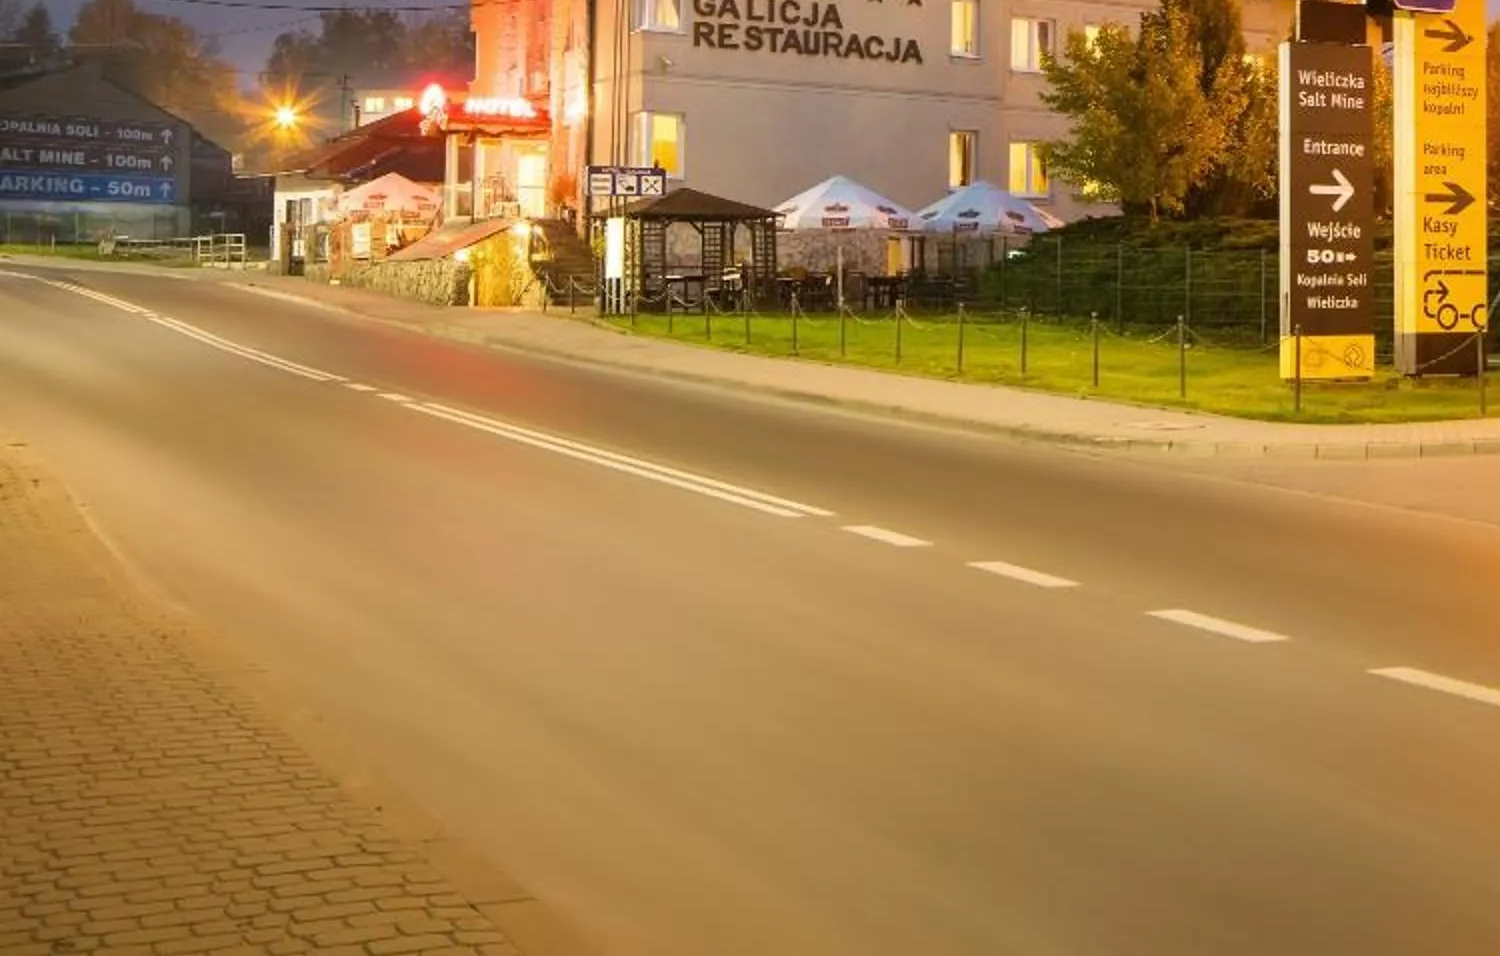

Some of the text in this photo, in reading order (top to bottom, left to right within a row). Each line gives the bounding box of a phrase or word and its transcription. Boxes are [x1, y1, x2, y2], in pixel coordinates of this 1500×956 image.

[693, 21, 923, 65] RESTAURACJA
[1299, 69, 1365, 89] Wieliczka
[1423, 61, 1465, 80] Parking
[1299, 91, 1364, 109] Salt Mine
[65, 124, 100, 138] SOLI
[116, 127, 153, 142] 100m
[1303, 138, 1365, 157] Entrance
[1423, 143, 1465, 161] Parking
[39, 149, 86, 165] MINE
[106, 153, 152, 169] 100m
[1423, 164, 1447, 175] area
[107, 181, 150, 197] 50m
[1423, 215, 1458, 236] Kasy
[1423, 243, 1471, 260] Ticket
